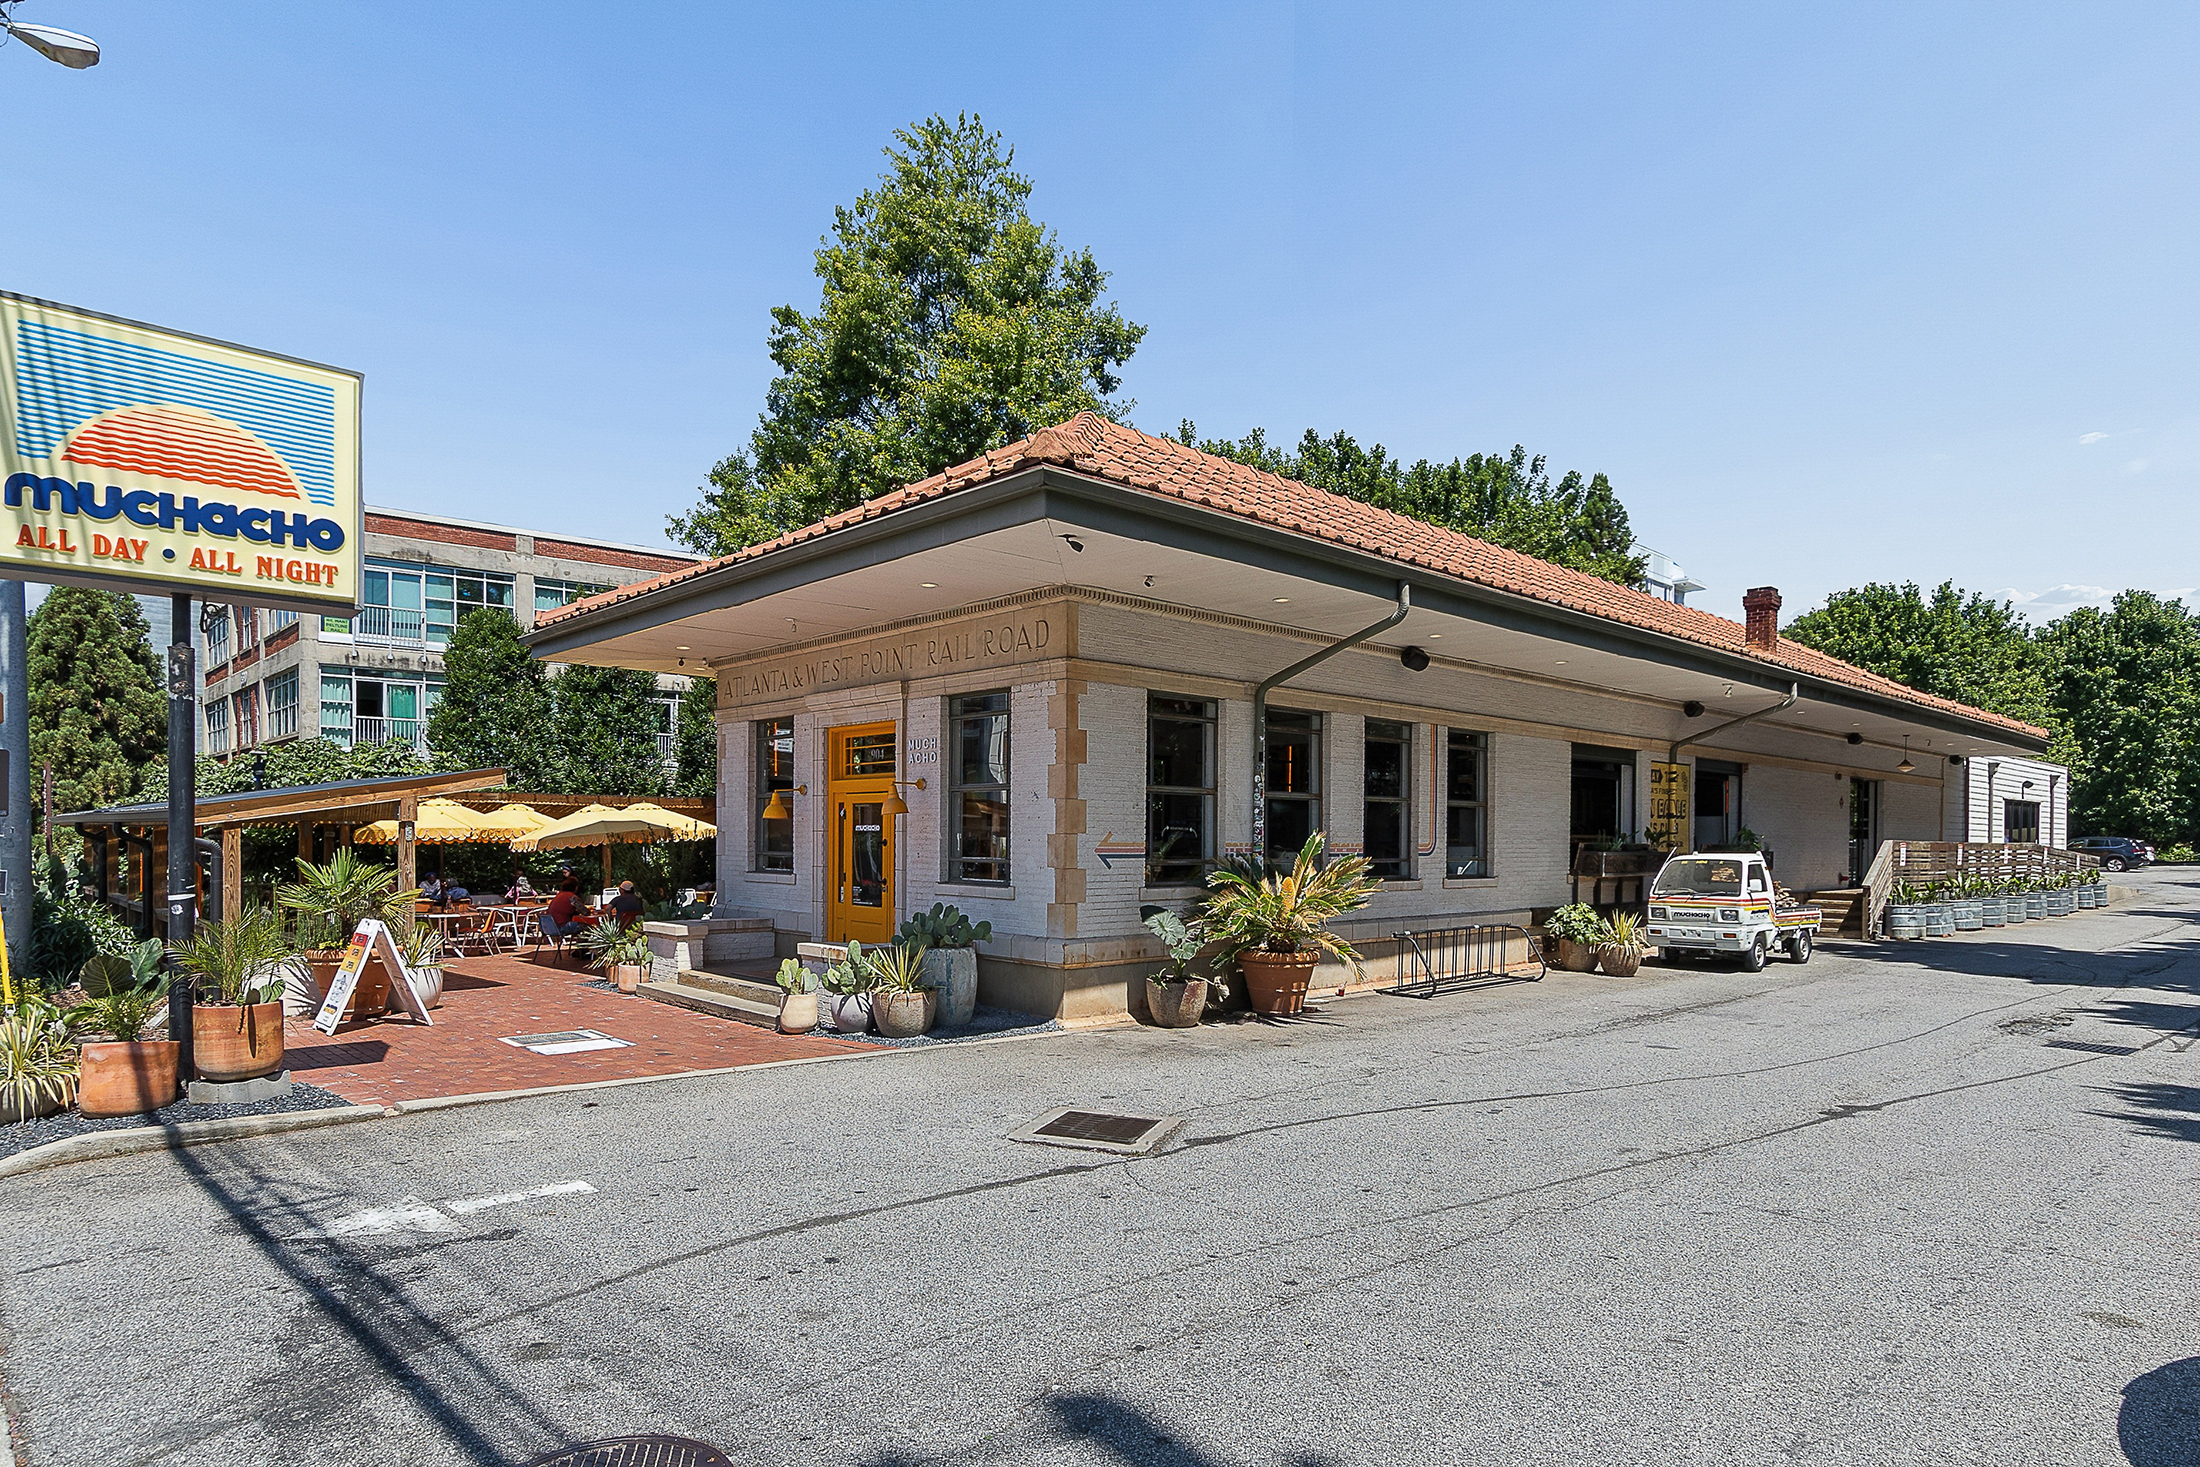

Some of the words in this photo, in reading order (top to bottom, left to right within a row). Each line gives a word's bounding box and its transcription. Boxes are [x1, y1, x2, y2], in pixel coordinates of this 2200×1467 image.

[16, 524, 77, 553] ALL
[93, 533, 149, 562] DAY
[190, 547, 243, 575] ALL
[256, 555, 339, 588] NIGHT
[723, 669, 789, 699] ATLANTA
[805, 656, 853, 685] WEST
[860, 643, 918, 677] POINT
[927, 633, 976, 667] RAIL
[983, 619, 1050, 657] ROAD
[908, 737, 938, 751] MUCH
[870, 748, 885, 760] 904
[908, 751, 938, 764] ACHO
